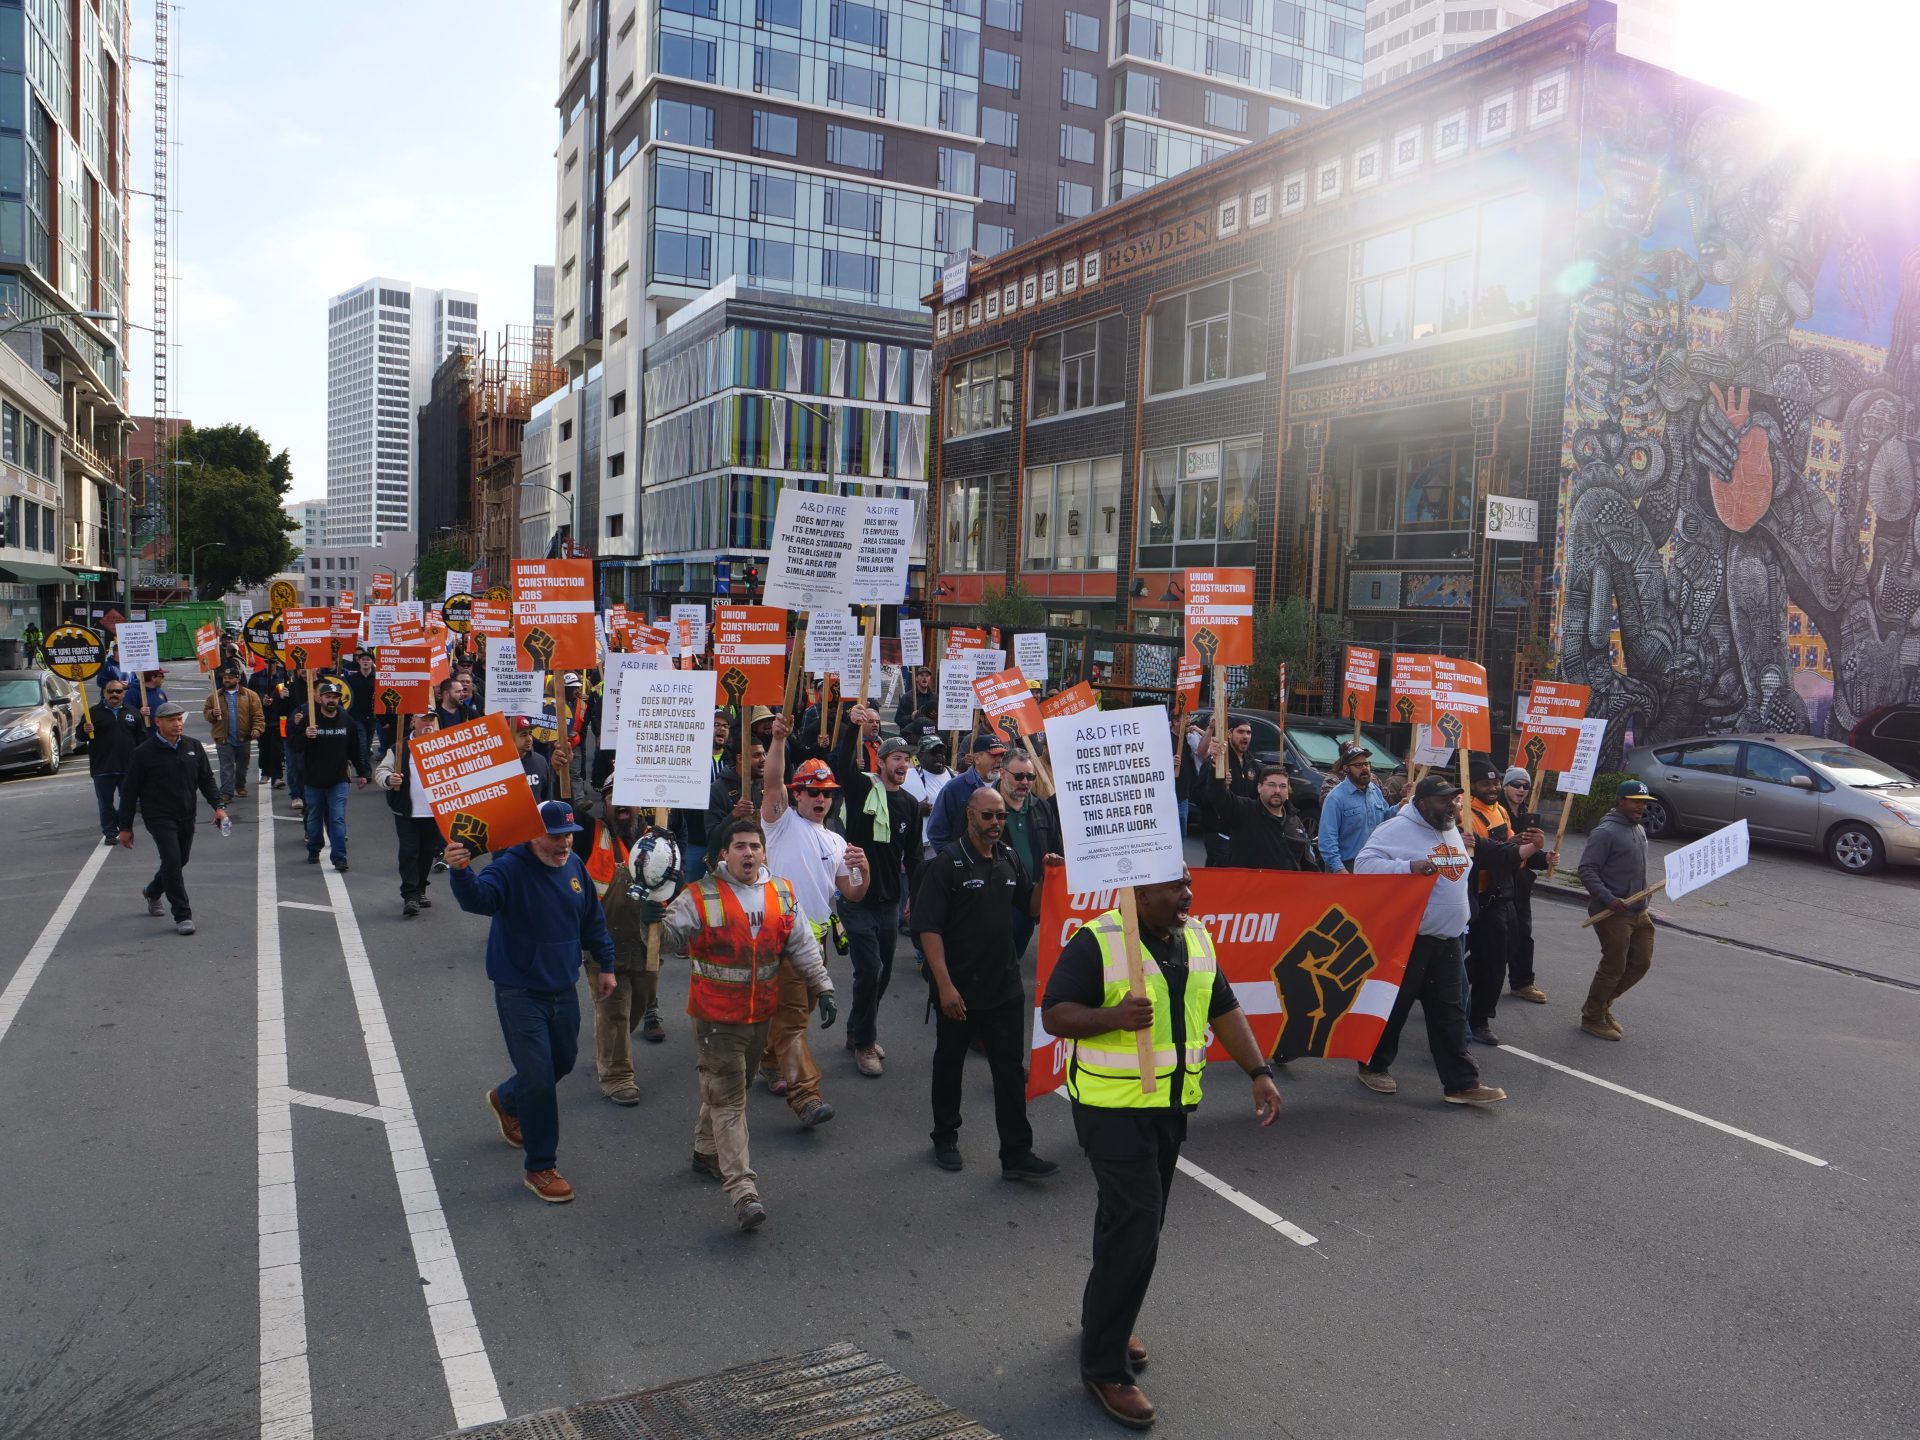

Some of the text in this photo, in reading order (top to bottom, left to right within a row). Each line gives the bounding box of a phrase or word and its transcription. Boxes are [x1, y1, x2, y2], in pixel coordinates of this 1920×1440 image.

[1107, 216, 1208, 270] HOWDEN
[801, 502, 846, 516] A&D FIRE
[867, 506, 899, 515] A&D FIRE
[1504, 505, 1536, 522] SPICE
[796, 516, 814, 524] DOES
[831, 520, 844, 528] PAY
[805, 528, 845, 538] EMPLOYEES
[782, 534, 852, 550] THE AREA STANDARD
[788, 546, 842, 559] ESTABLISHED IN
[788, 556, 803, 565] THIS
[517, 565, 545, 574] UNION
[786, 566, 814, 576] SIMILAR
[1190, 573, 1213, 581] UNION
[518, 578, 584, 587] CONSTRUCTION
[1190, 584, 1245, 592] CONSTRUCTION
[519, 590, 542, 600] JOBS
[1191, 595, 1210, 603] JOBS
[520, 604, 536, 612] FOR
[1191, 606, 1204, 614] FOR
[721, 610, 746, 619] UNION
[520, 615, 577, 625] OAKLANDERS
[721, 622, 779, 631] CONSTRUCTION
[721, 634, 741, 642] JOBS
[72, 647, 88, 655] FIGHTS
[55, 655, 96, 664] WORKING PEOPLE
[720, 656, 770, 664] OAKLANDERS
[1435, 661, 1456, 670] UNION
[1436, 672, 1482, 685] CONSTRUCTION
[650, 684, 693, 693] A&D FIRE
[976, 679, 994, 689] UNION
[980, 679, 1020, 696] CONSTRUCTION
[1435, 682, 1452, 690] JOBS
[1536, 686, 1556, 694] UNION
[642, 697, 694, 705] DOES NOT PAY
[984, 694, 998, 704] JOBS
[1436, 692, 1447, 700] FOR
[1534, 696, 1581, 707] CONSTRUCTION
[990, 702, 1025, 717] OAKLANDERS
[1435, 702, 1478, 713] OAKLANDERS
[1531, 706, 1548, 714] JOBS
[652, 709, 696, 717] EMPLOYEES
[628, 720, 705, 730] THE AREA STANDARD
[1076, 723, 1140, 741] A&D FIRE
[1527, 725, 1567, 736] OAKLANDERS
[416, 724, 488, 755] TRABAJOS DE
[636, 733, 695, 742] ESTABLISHED IN
[422, 734, 503, 770] CONSTRUCCIÓN
[637, 744, 691, 754] THIS AREA FOR
[1077, 742, 1144, 759] DOES NOT PAY
[636, 756, 692, 766] SIMILAR WORK
[1076, 757, 1150, 775] ITS EMPLOYEES
[427, 755, 493, 785] DE LA UNIÓN
[1066, 771, 1165, 792] THE AREA STANDARD
[432, 782, 461, 799] PARA
[437, 784, 508, 815] OAKLANDERS
[1080, 788, 1155, 806] ESTABLISHED IN
[1083, 803, 1153, 821] THIS AREA FOR
[1086, 819, 1157, 837] SIMILAR WORK
[1070, 887, 1121, 911] UNI
